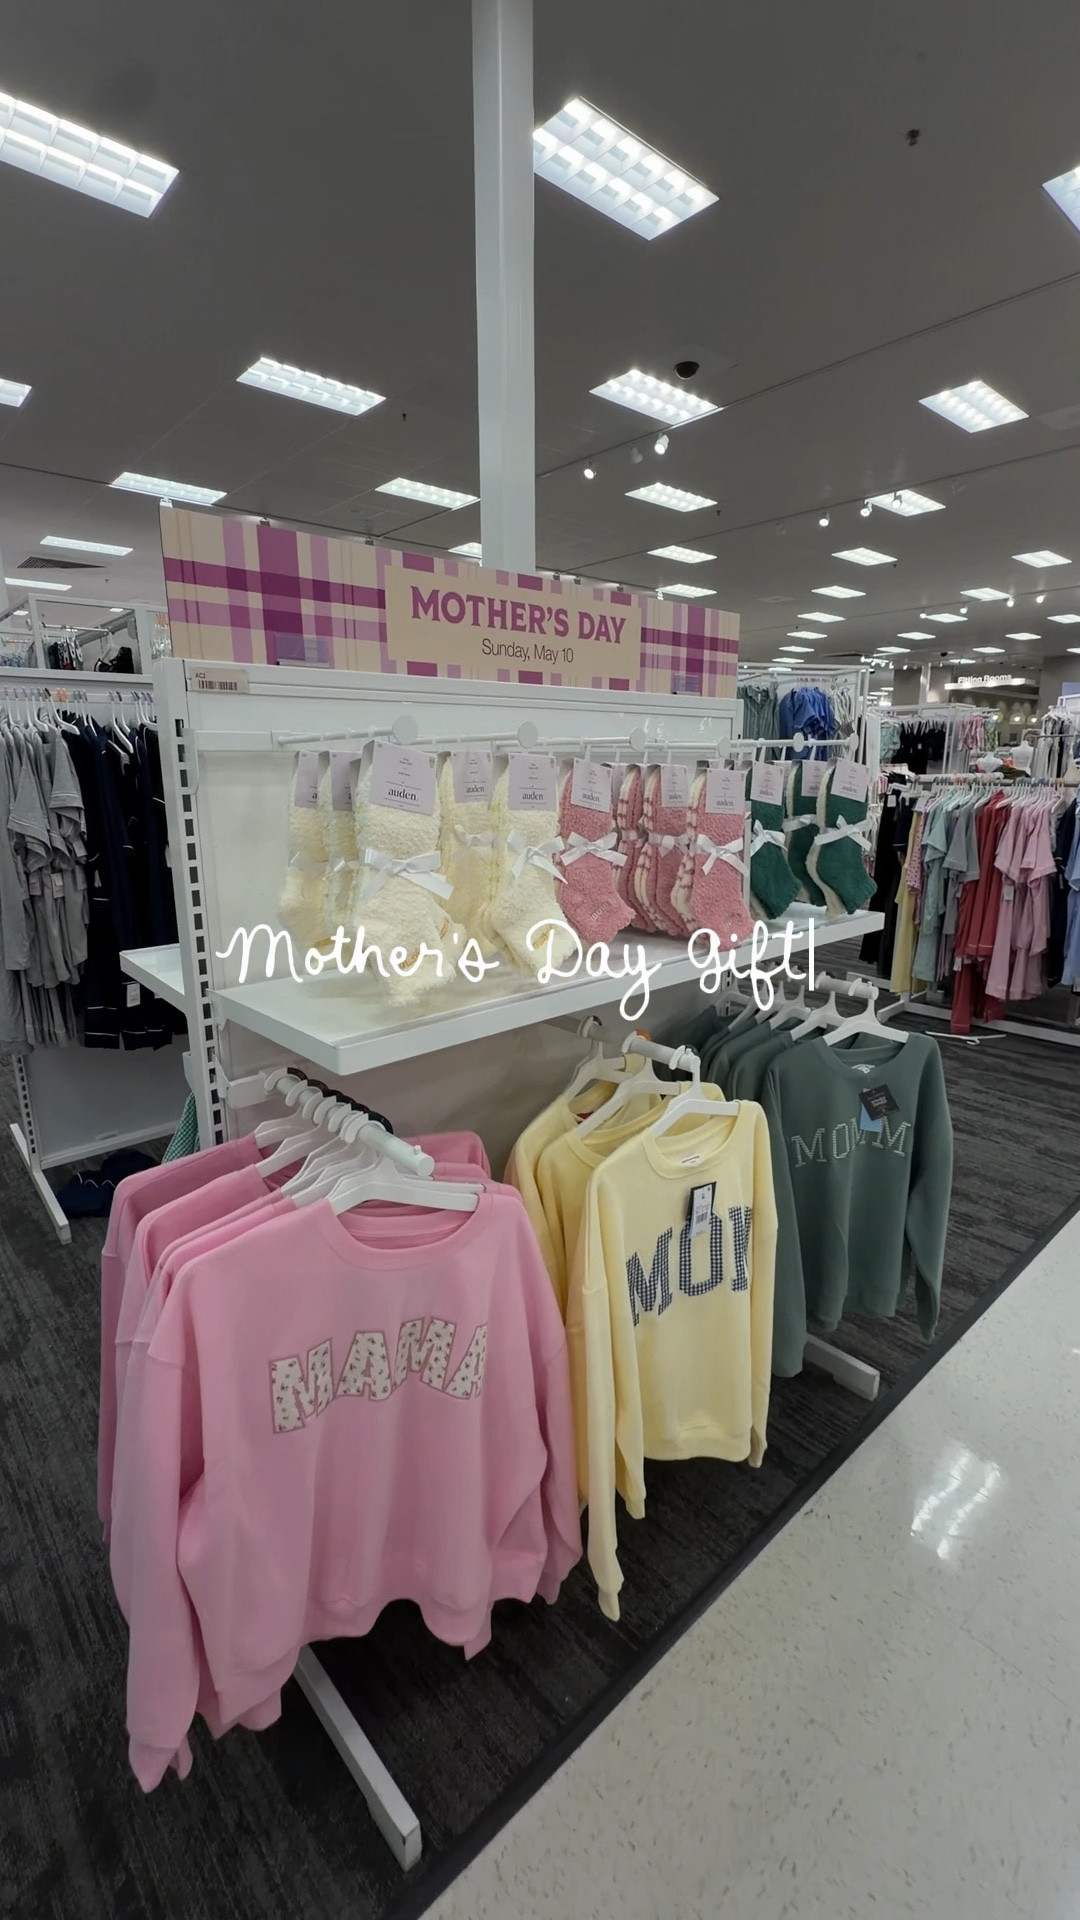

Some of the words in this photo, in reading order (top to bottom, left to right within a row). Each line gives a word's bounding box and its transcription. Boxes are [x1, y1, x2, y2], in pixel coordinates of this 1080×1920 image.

[410, 585, 570, 638] MOTHER'S
[577, 611, 627, 644] DAY
[481, 638, 531, 662] Sunday,
[533, 643, 559, 665] May
[560, 647, 575, 663] 10
[388, 788, 418, 801] auden
[466, 784, 485, 794] auden
[522, 790, 544, 801] auden
[269, 1316, 488, 1435] MAMA
